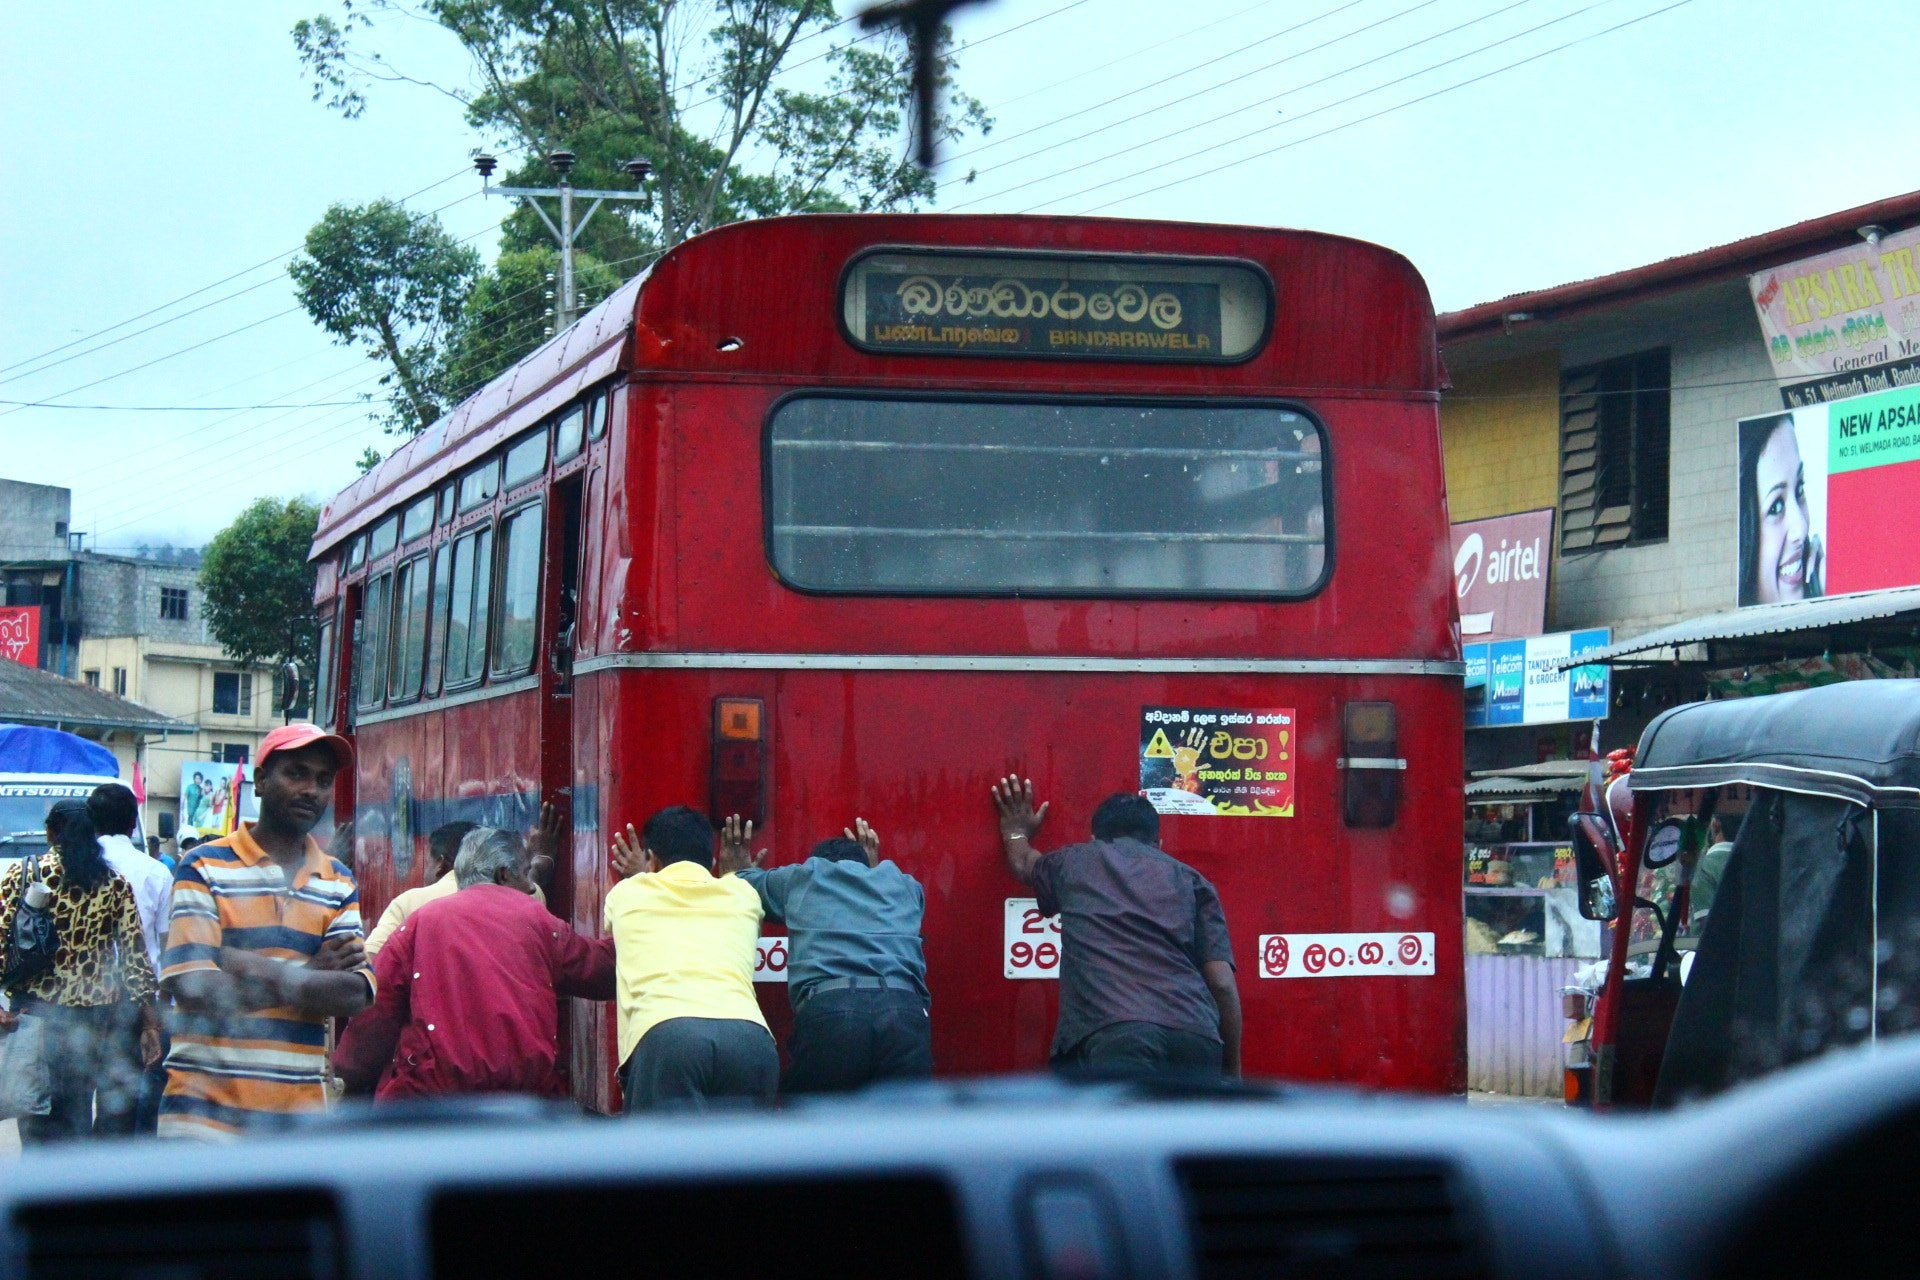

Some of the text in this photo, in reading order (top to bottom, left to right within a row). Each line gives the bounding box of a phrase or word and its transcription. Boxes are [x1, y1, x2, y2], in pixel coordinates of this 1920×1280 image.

[1782, 258, 1884, 328] APSARA
[1880, 243, 1920, 300] TR
[1049, 329, 1211, 349] BANDARAWELA
[1833, 344, 1888, 372] General
[1820, 378, 1864, 401] Welimada
[1840, 412, 1872, 439] NEW
[1860, 439, 1891, 454] WELIMADA
[1487, 537, 1540, 584] airtel
[1492, 656, 1523, 674] Telecom
[1528, 659, 1549, 670] TANIYA
[1529, 675, 1534, 685] &
